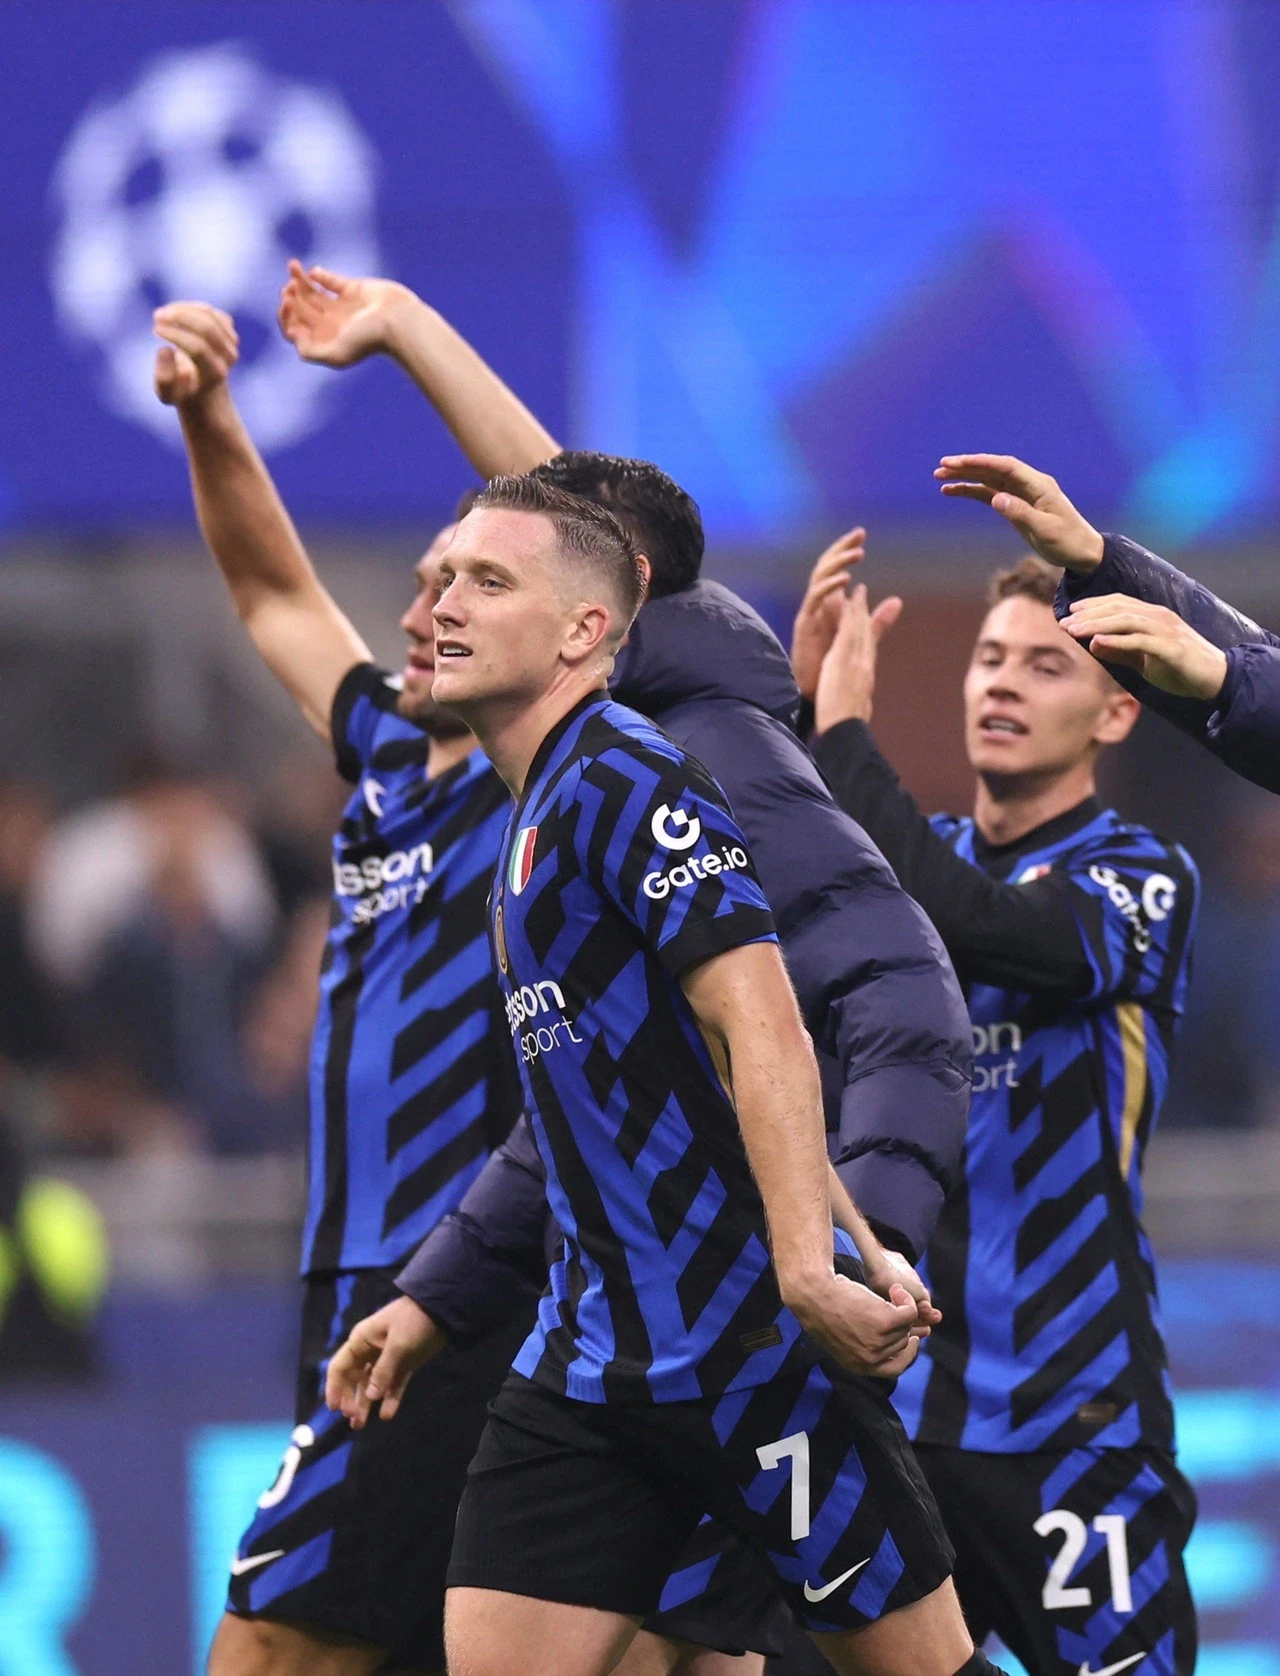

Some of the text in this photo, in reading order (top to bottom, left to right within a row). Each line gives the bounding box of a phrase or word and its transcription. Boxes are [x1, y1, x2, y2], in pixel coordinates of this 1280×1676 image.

[643, 845, 748, 899] Gate.io
[521, 1015, 583, 1065] .sport
[755, 1430, 810, 1541] 7
[1032, 1509, 1133, 1612] 21
